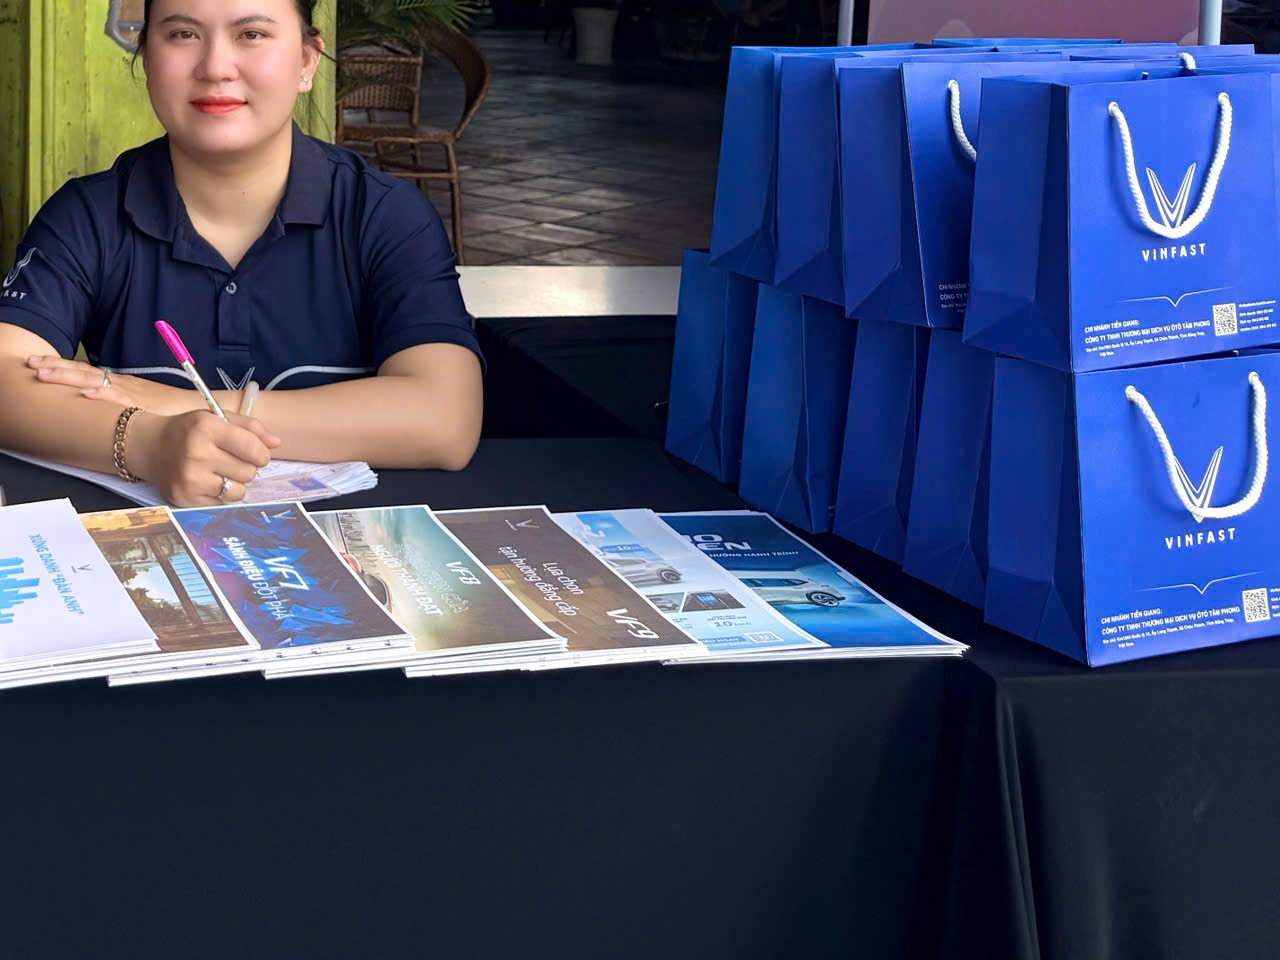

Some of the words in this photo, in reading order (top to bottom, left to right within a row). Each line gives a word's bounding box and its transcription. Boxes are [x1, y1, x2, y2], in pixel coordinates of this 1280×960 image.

[1141, 242, 1207, 262] VINFAST
[1165, 527, 1236, 550] VINFAST
[263, 556, 310, 591] VF7
[606, 608, 660, 639] VF9
